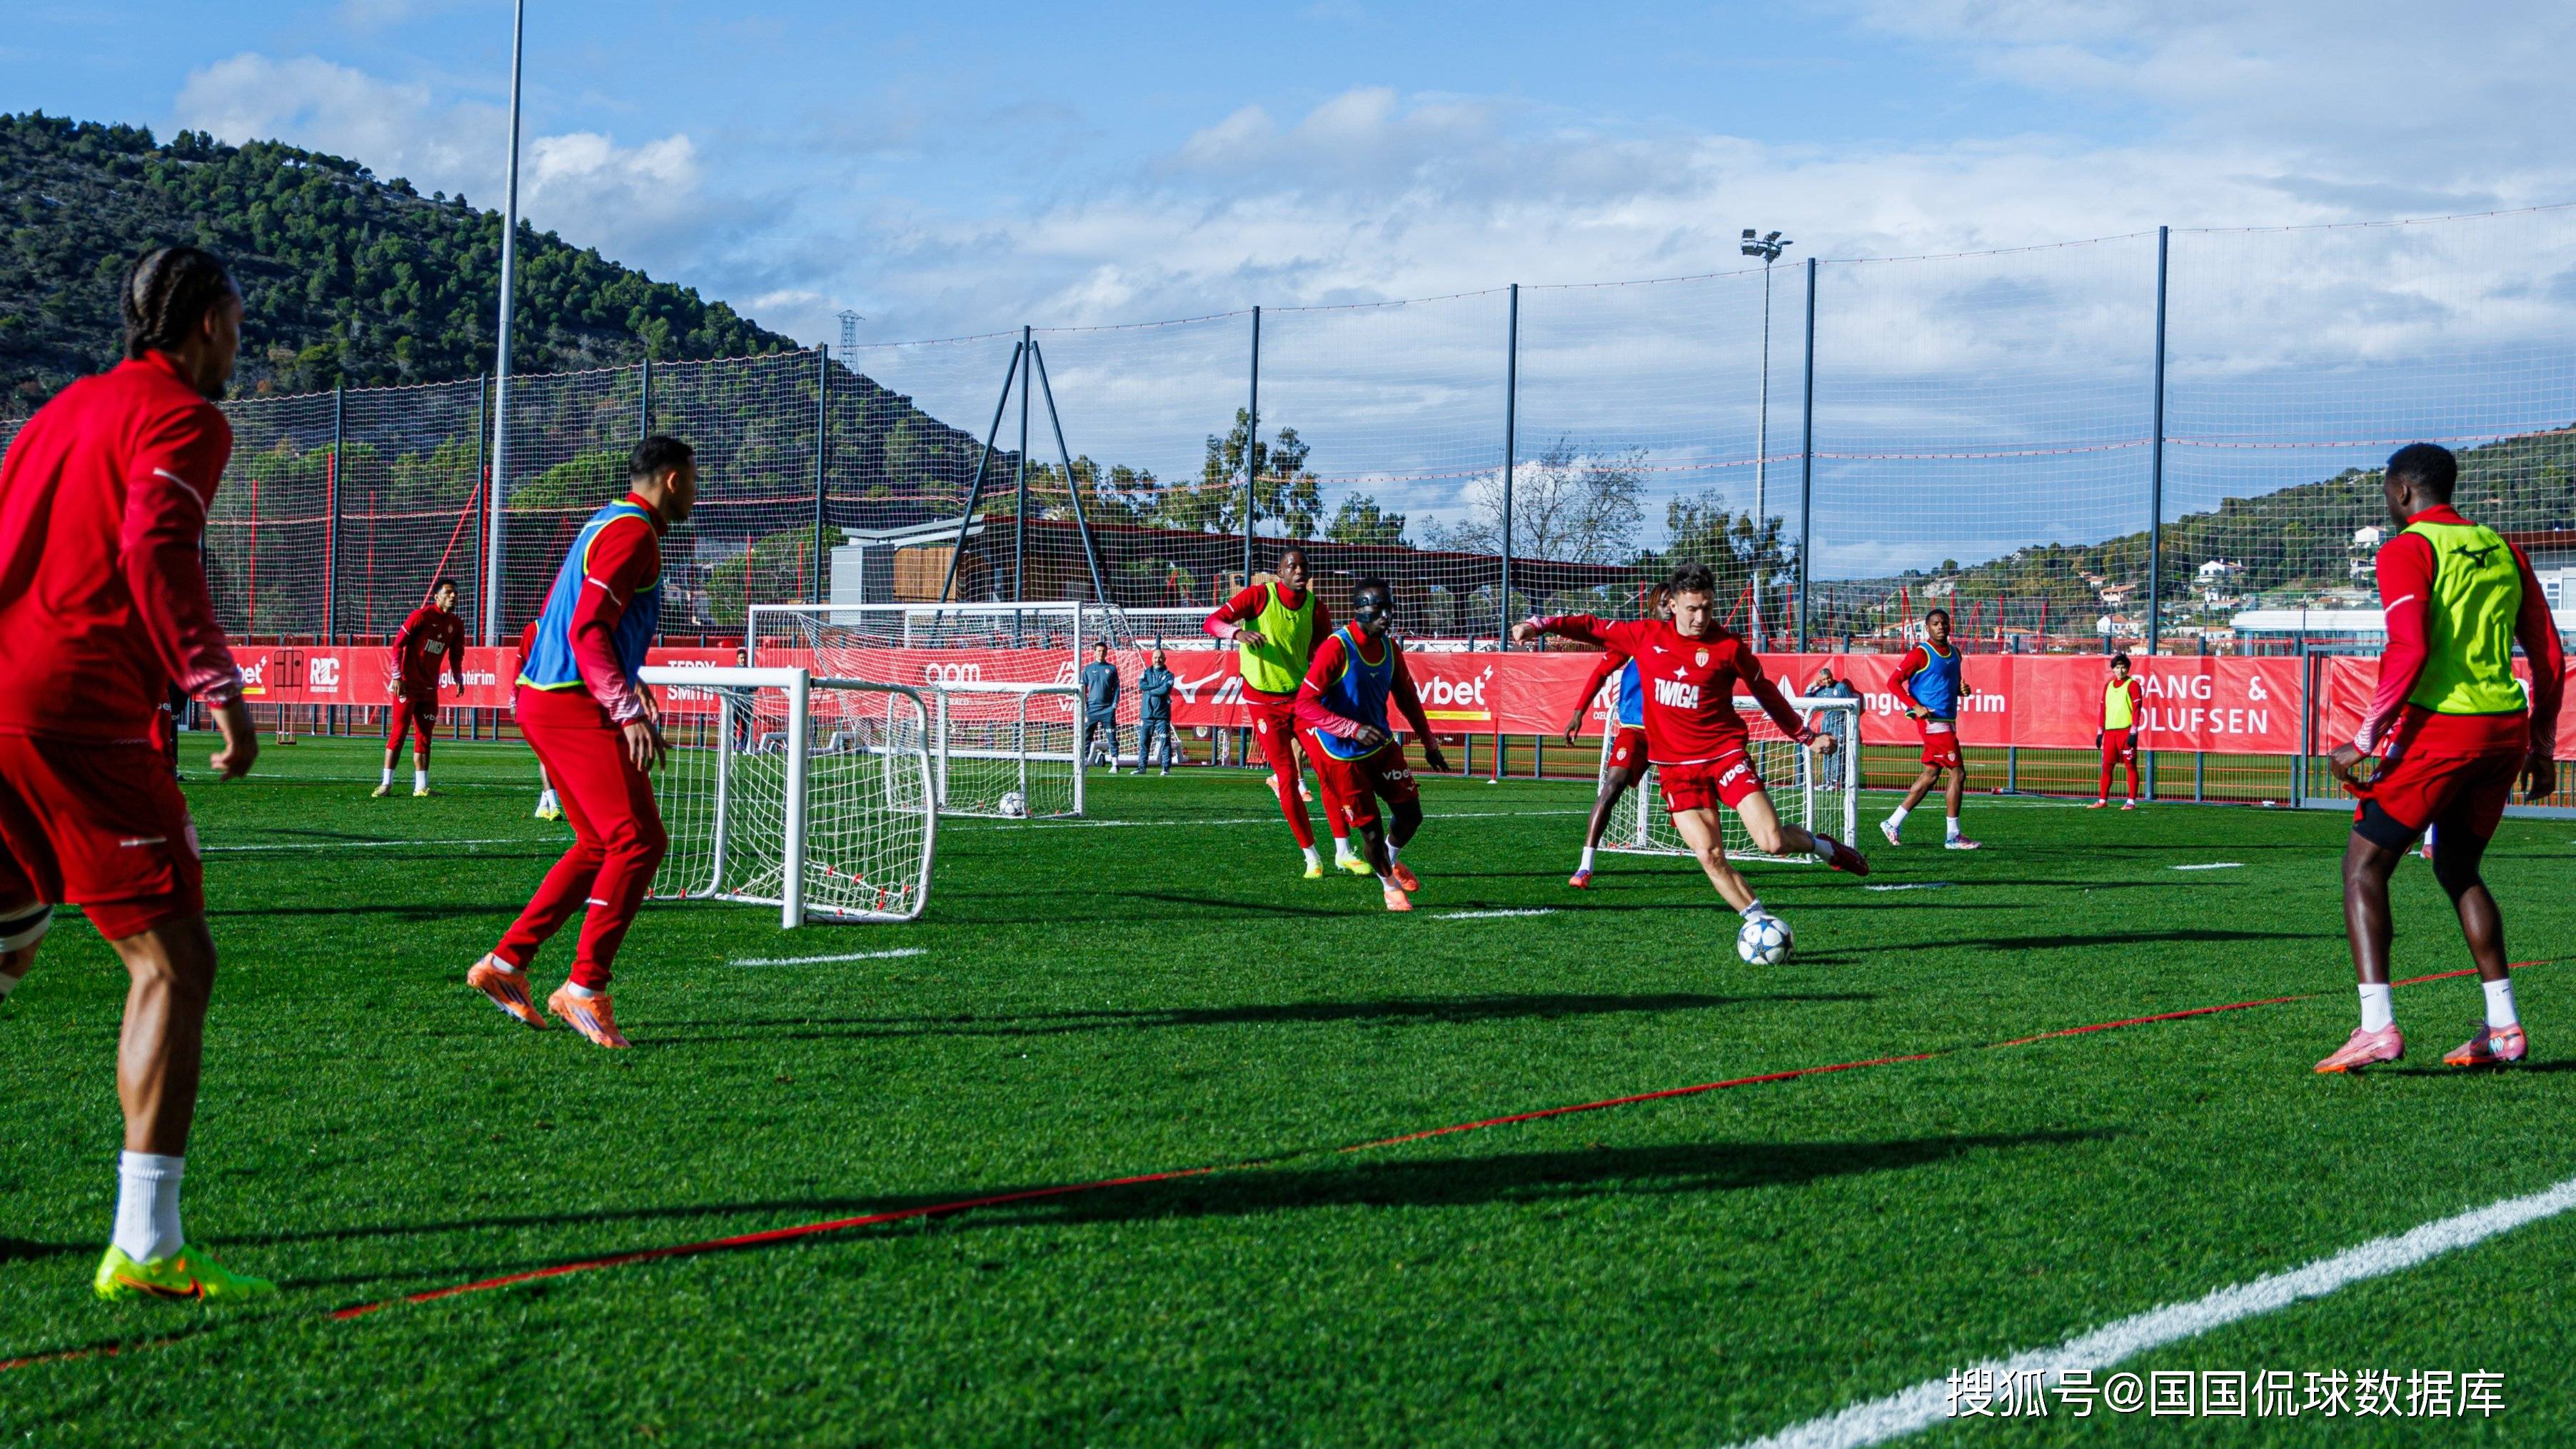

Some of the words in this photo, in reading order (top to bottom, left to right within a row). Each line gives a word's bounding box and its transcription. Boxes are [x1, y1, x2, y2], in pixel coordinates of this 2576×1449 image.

[1414, 675, 1486, 706] vbet
[1654, 678, 1700, 709] TWIGA
[2248, 676, 2268, 701] &
